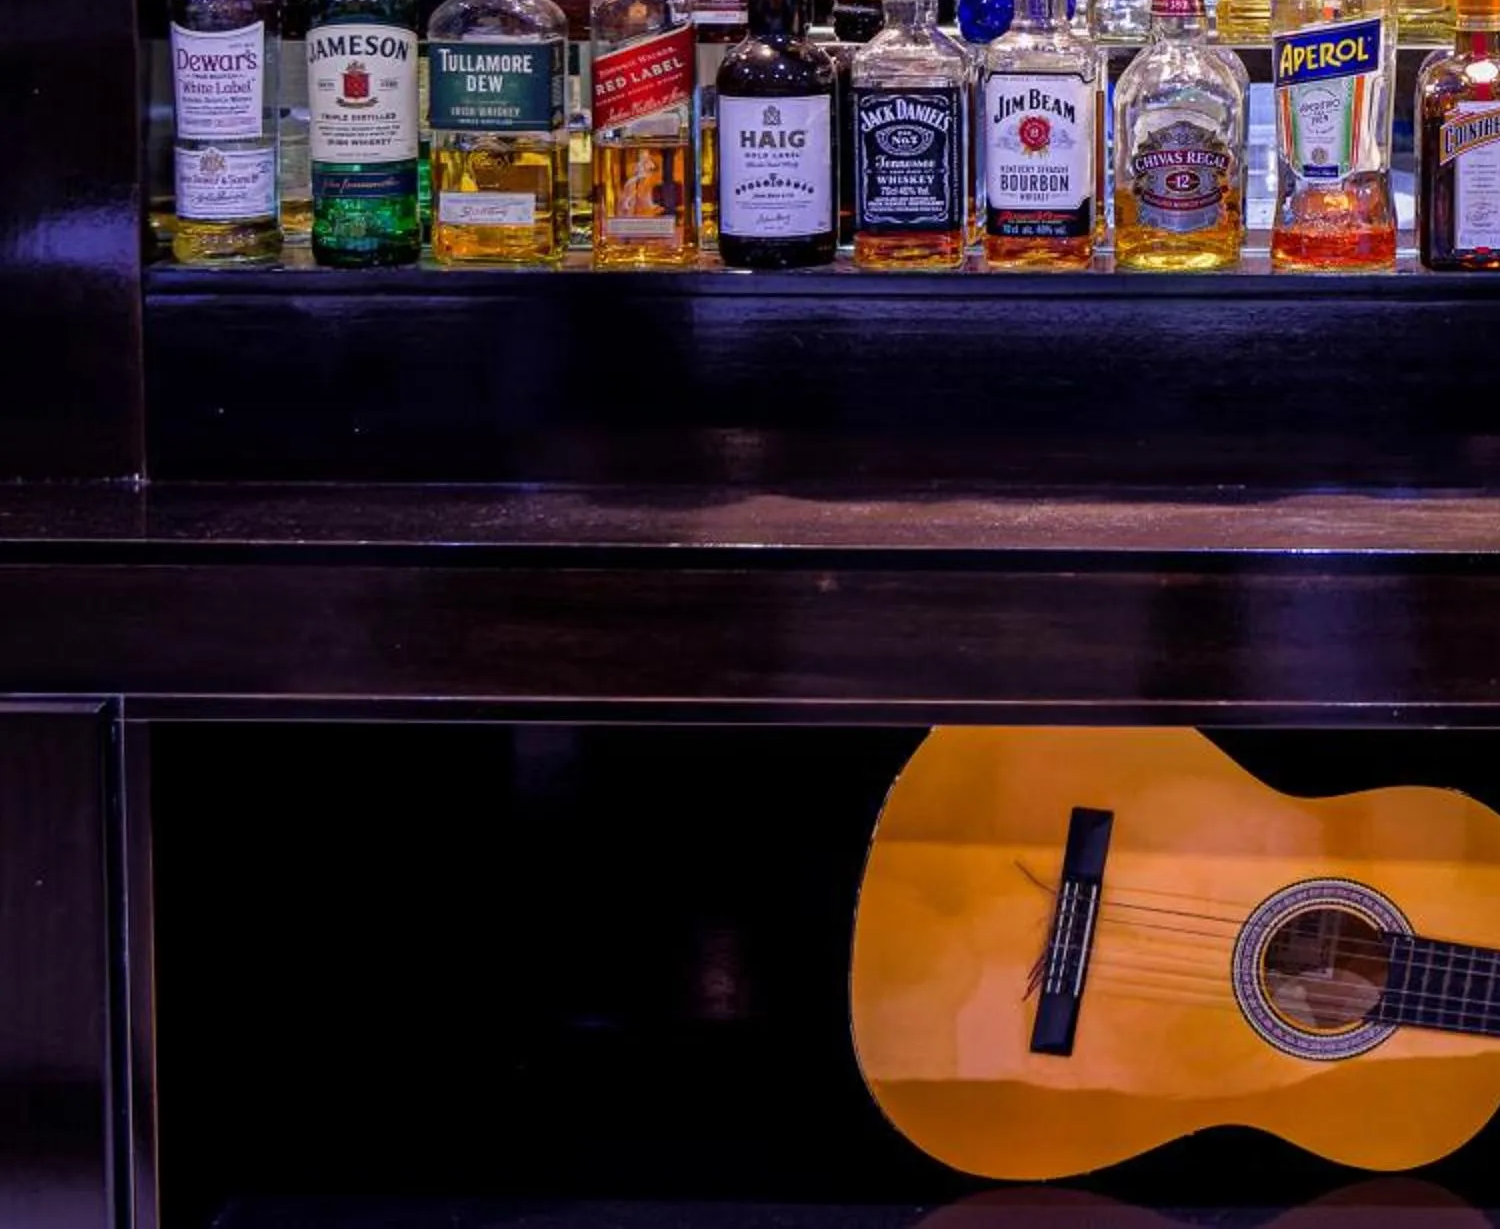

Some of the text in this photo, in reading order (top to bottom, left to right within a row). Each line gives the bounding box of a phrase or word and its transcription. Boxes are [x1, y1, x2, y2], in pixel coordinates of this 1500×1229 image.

[176, 48, 257, 72] Dewar's
[308, 35, 409, 64] JAMESON
[438, 48, 533, 73] TULLAMORE
[1280, 36, 1368, 78] APEROL
[466, 75, 504, 92] DEW
[595, 58, 683, 96] RED LABEL
[861, 99, 950, 132] JACK DANIEL'S
[993, 88, 1076, 124] JIM BEAM
[740, 130, 806, 148] HAIG
[1135, 152, 1227, 172] CHIVAS REGAL
[876, 175, 935, 185] WHISKEY
[1001, 174, 1070, 192] BOURBON
[1175, 176, 1190, 188] 12
